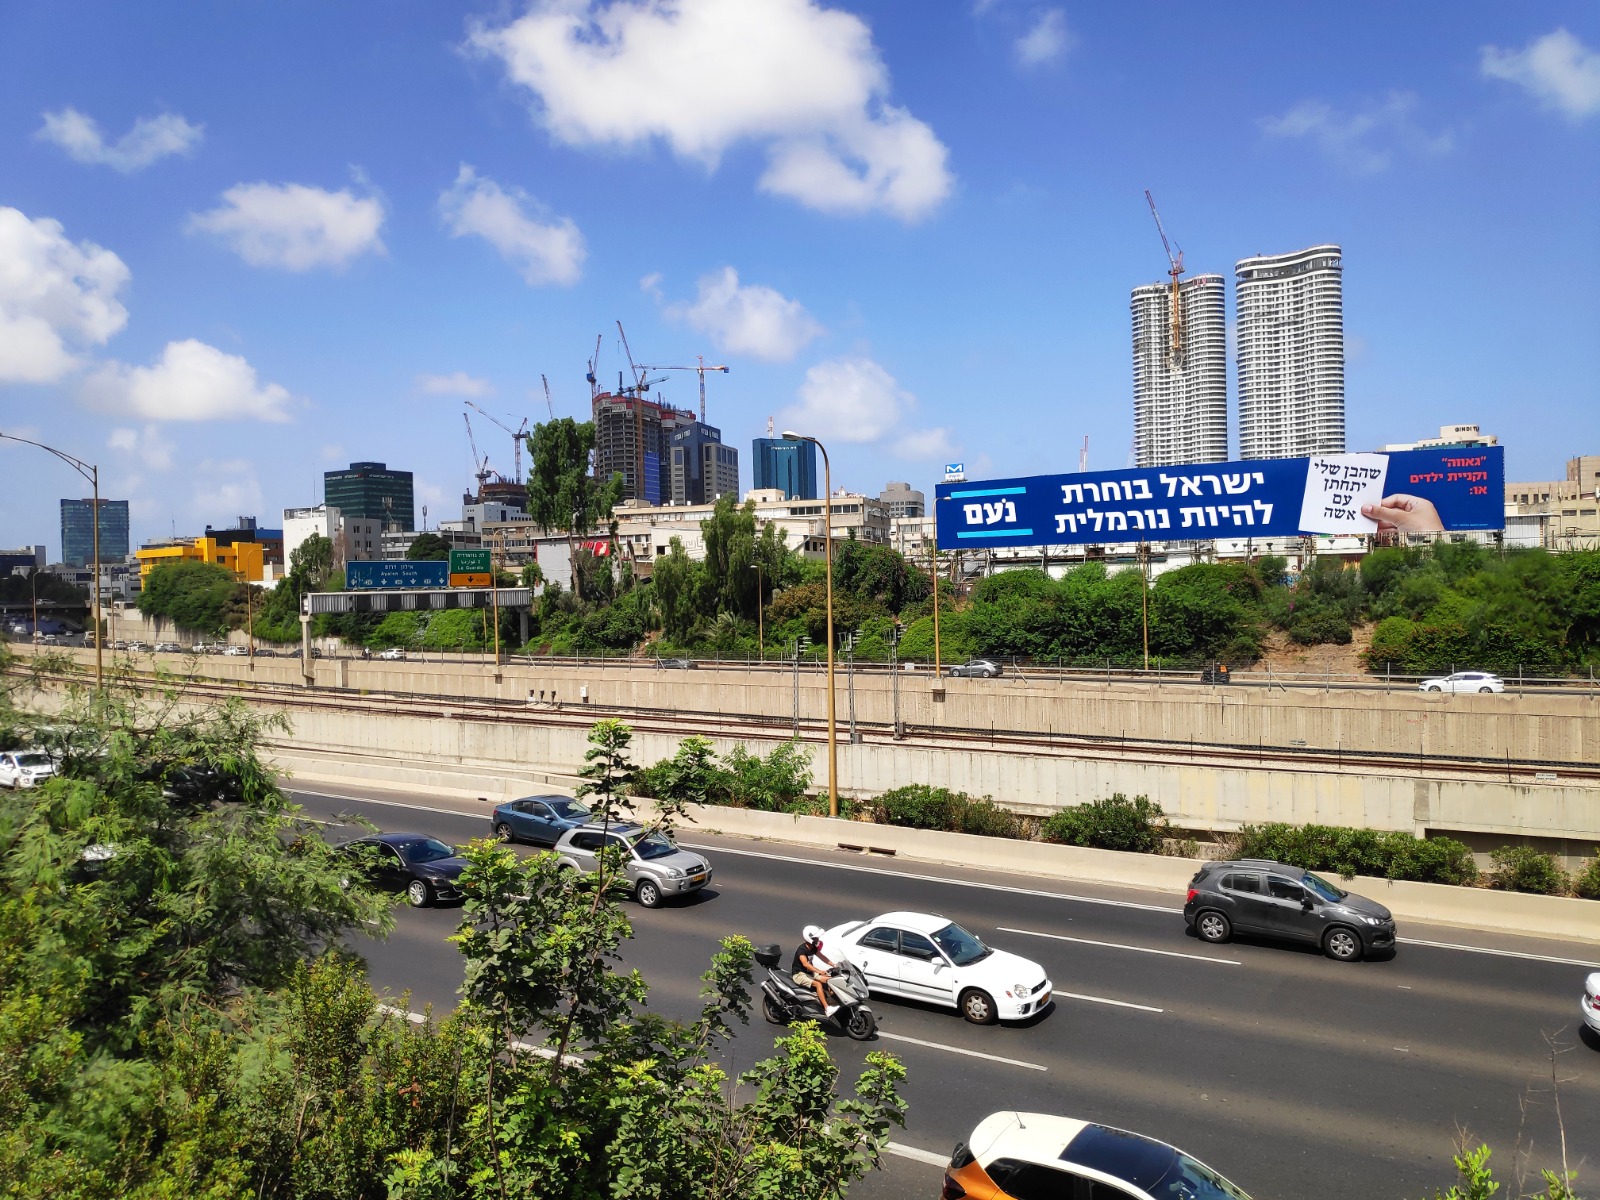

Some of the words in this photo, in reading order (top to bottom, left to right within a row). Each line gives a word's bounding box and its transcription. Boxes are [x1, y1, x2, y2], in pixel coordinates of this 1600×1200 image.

[1314, 459, 1341, 476] שלי
[1344, 465, 1382, 480] שהבן
[1409, 472, 1444, 484] ילדים
[1447, 471, 1488, 482] וקניית
[1061, 479, 1153, 504] בוחרת
[1160, 472, 1265, 498] ישראל
[1324, 478, 1367, 492] יתחתן
[1332, 493, 1353, 506] עם
[1054, 508, 1171, 534] נורמלית
[1180, 499, 1274, 528] להיות
[1323, 506, 1357, 521] אשה
